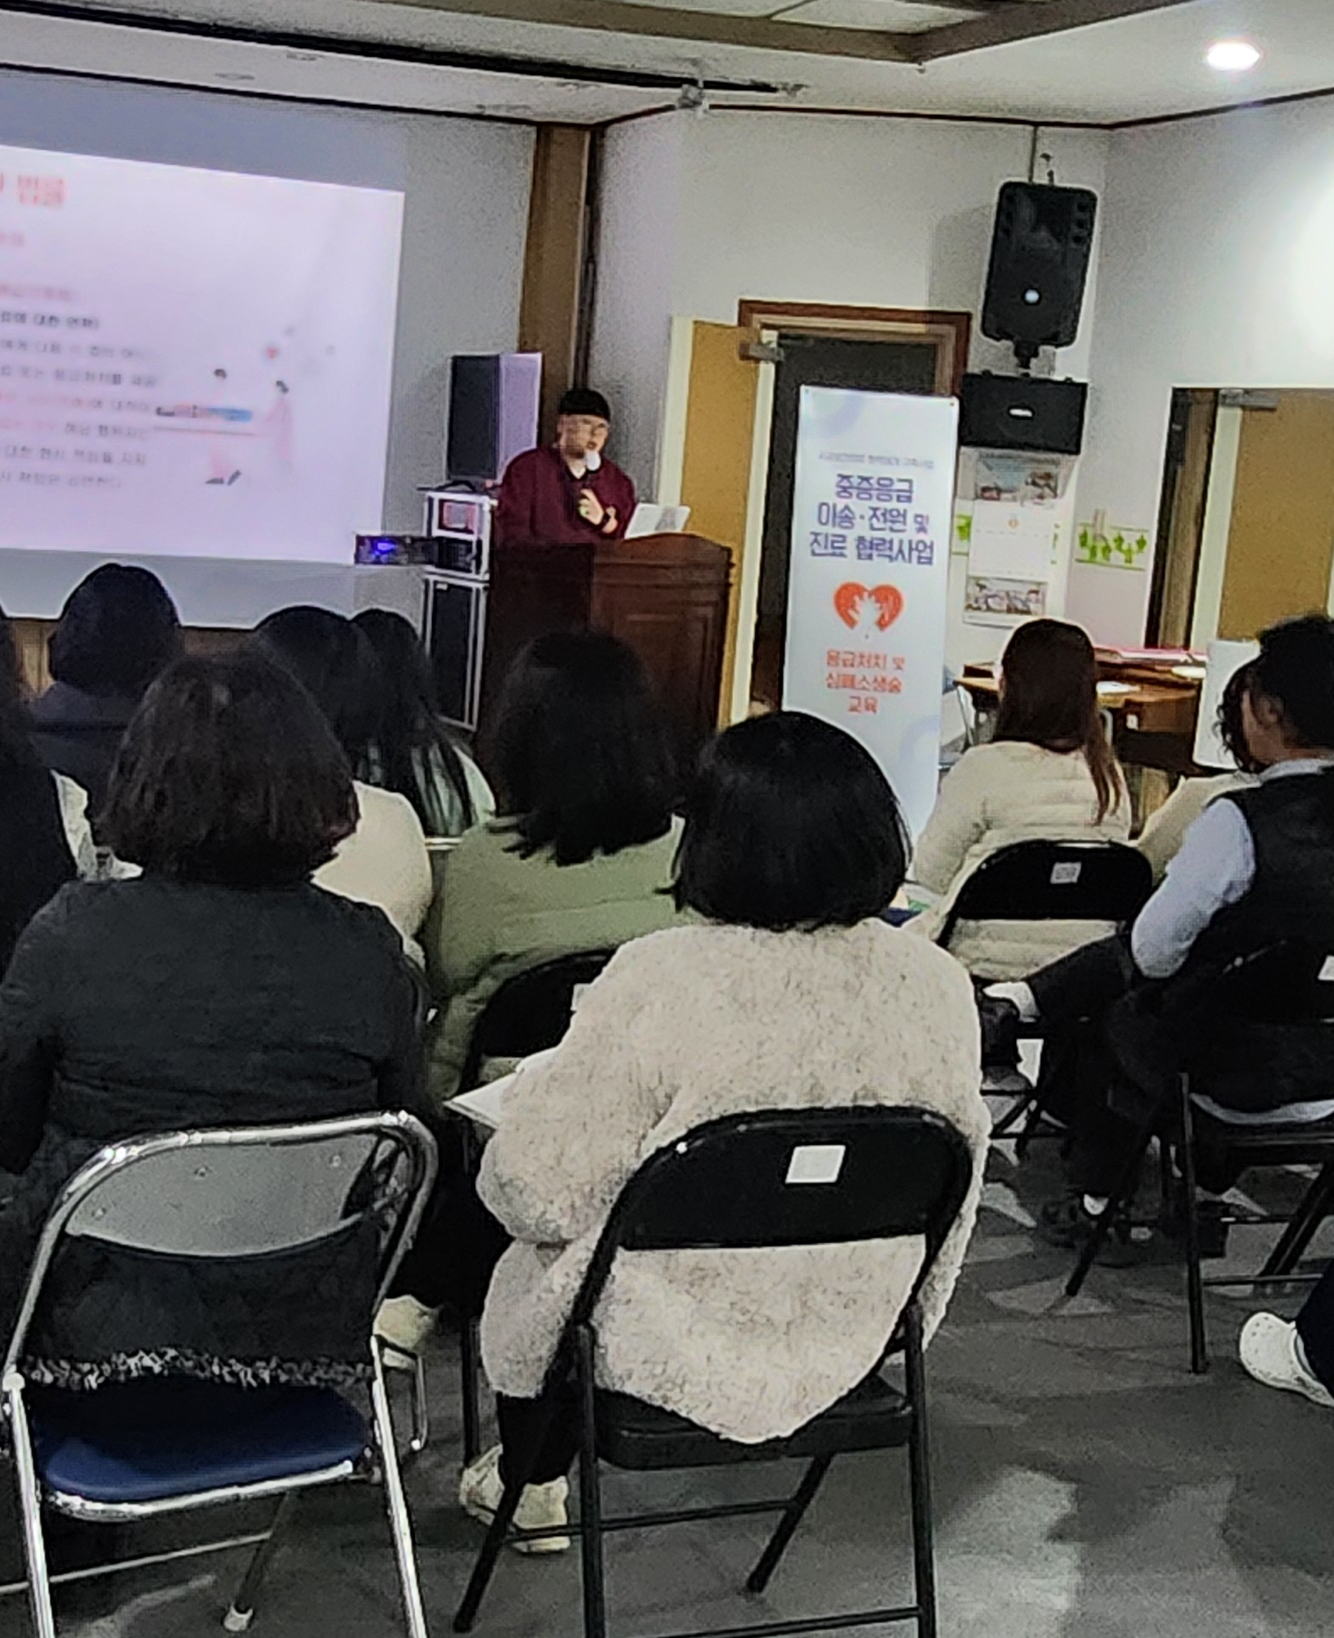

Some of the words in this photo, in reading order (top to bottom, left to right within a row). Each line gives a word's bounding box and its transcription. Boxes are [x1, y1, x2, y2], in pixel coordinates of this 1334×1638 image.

[17, 173, 65, 208] 법률
[835, 473, 913, 503] 중증응급
[817, 502, 907, 533] 이송·전원
[913, 513, 930, 534] 및
[809, 531, 848, 558] 진료
[855, 535, 934, 566] 협력사업
